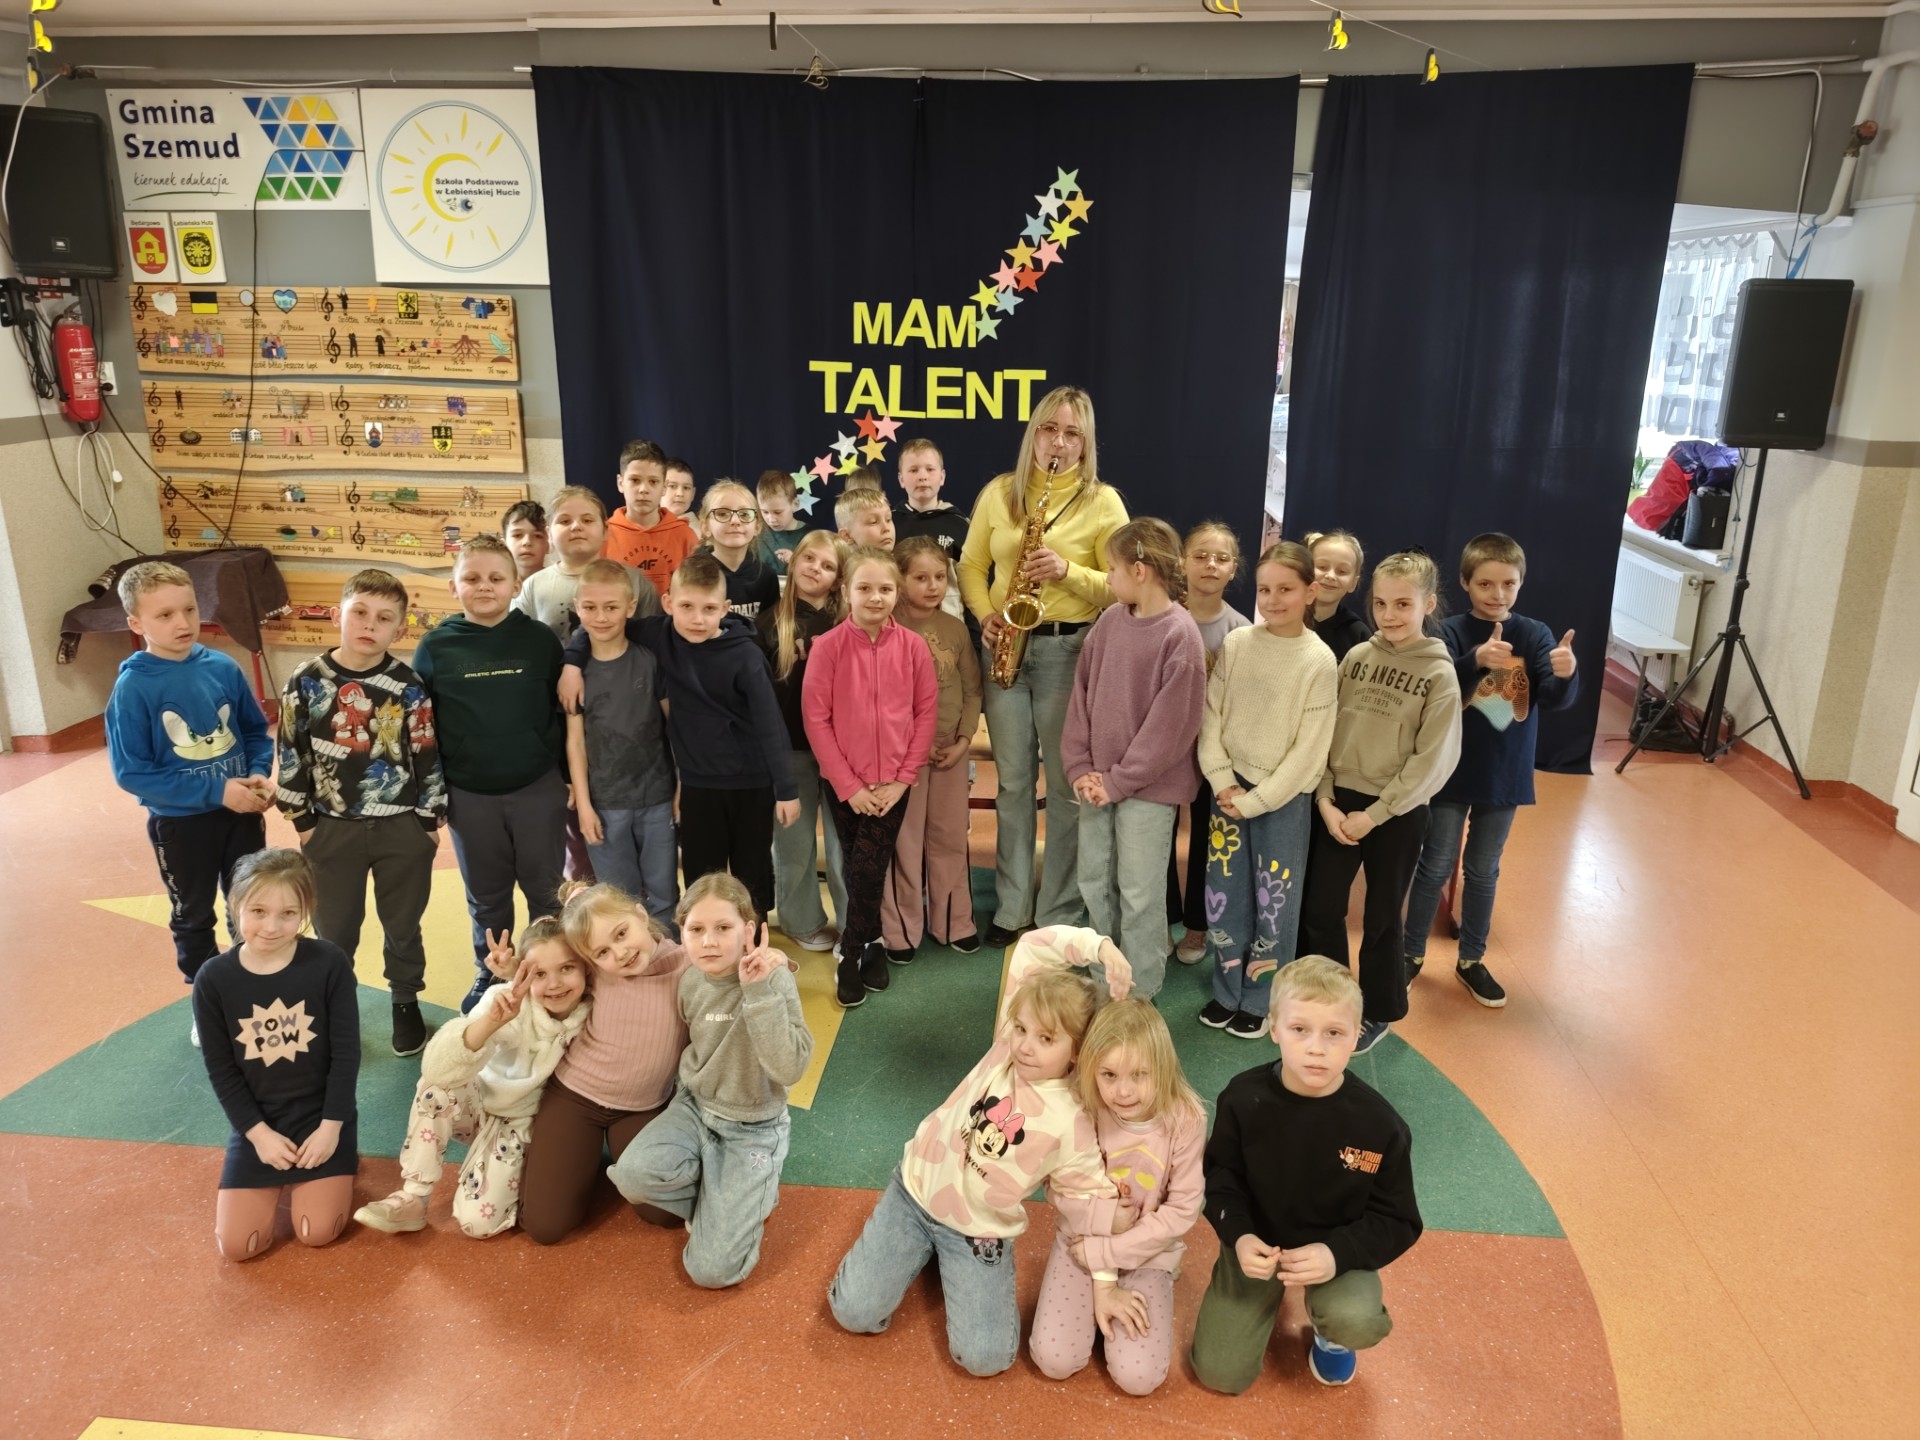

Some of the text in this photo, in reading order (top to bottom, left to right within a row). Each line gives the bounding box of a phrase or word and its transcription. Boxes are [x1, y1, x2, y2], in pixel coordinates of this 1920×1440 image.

[119, 99, 215, 124] Gmina
[123, 132, 240, 159] Szemud
[134, 172, 229, 196] kierunek edukacja
[445, 188, 494, 197] Łebieńskiej
[854, 299, 977, 349] MAM
[809, 360, 1047, 422] TALENT
[623, 545, 673, 564] PORTSWEAR
[728, 601, 761, 619] SDALE
[362, 673, 408, 696] ONIC
[1343, 660, 1432, 698] LOS ANGELES
[1380, 690, 1404, 706] FOREVER
[311, 735, 353, 760] ONIC
[251, 1012, 297, 1037] POW
[705, 1012, 735, 1022] GO GIRL
[254, 1028, 300, 1053] POW
[1361, 1150, 1383, 1164] YOUR
